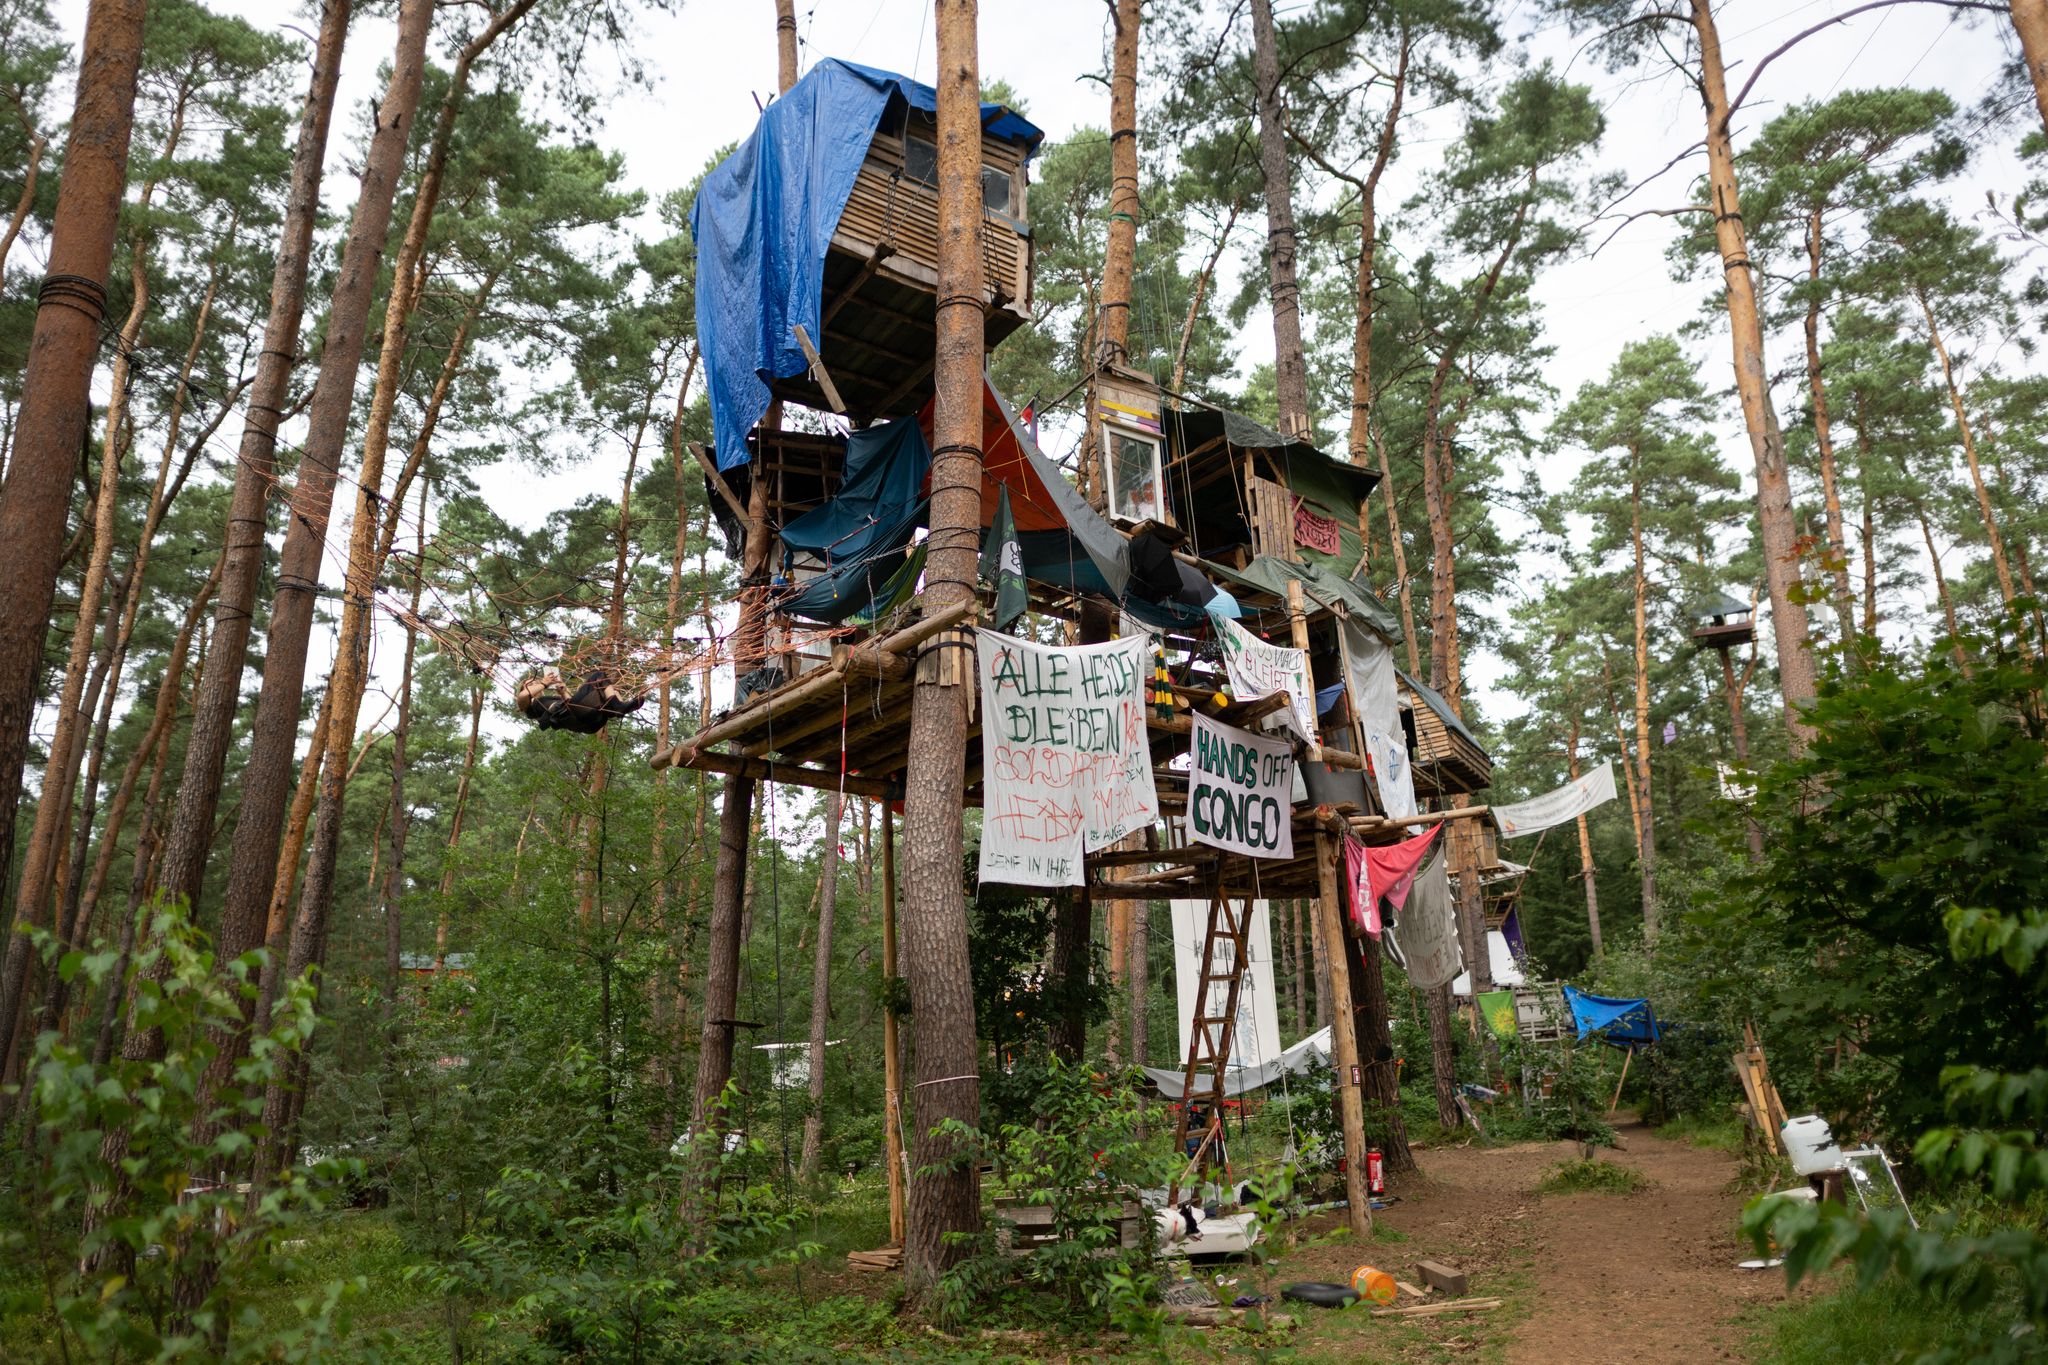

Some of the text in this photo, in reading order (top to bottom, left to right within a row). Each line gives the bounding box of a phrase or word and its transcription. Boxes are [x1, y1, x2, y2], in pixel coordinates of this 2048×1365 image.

[992, 645, 1072, 699] ALLE
[1197, 725, 1290, 790] HANDS OFF
[1193, 783, 1281, 850] CONGO
[1028, 855, 1041, 876] IN
[1046, 855, 1073, 878] IHRE
